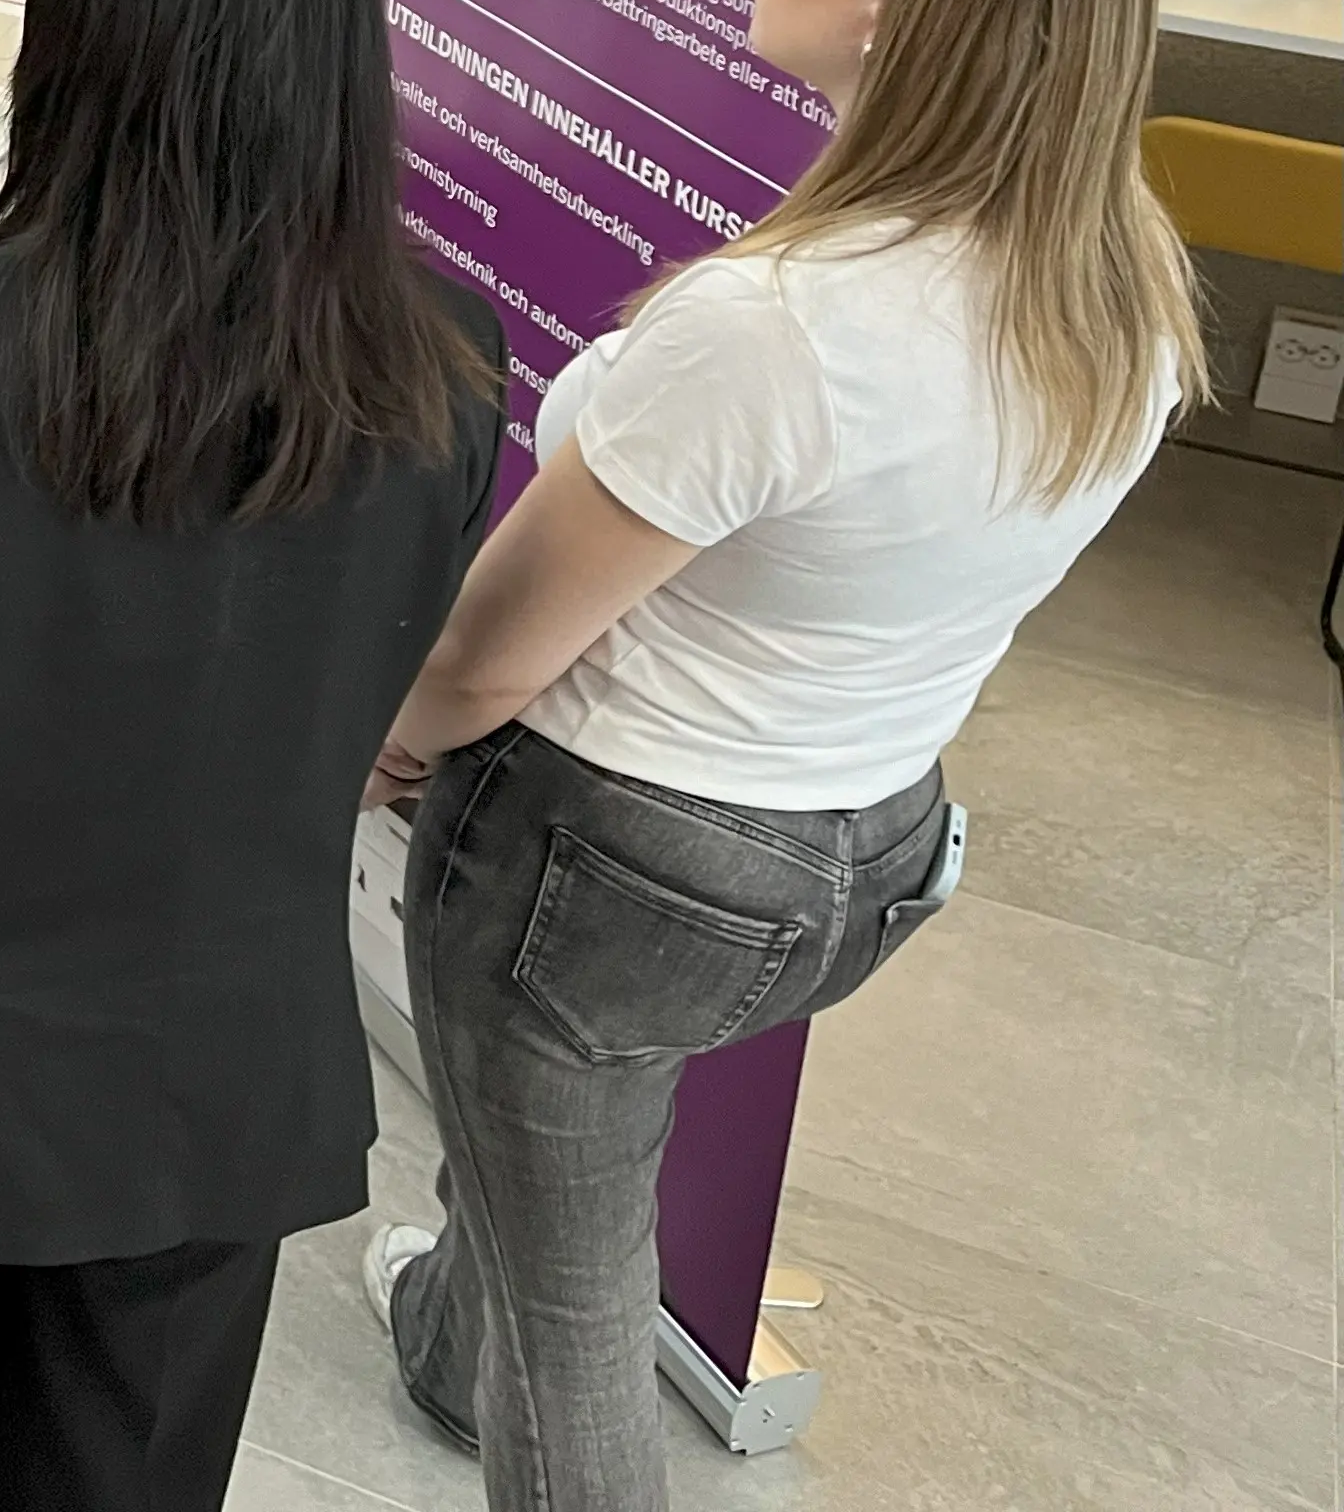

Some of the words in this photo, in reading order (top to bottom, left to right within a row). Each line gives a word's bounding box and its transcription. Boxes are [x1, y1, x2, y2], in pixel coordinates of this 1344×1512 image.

[728, 61, 770, 93] eller
[771, 84, 800, 111] att
[391, 71, 438, 118] valitet
[440, 107, 466, 137] och
[470, 126, 655, 266] verksamhetsutveckling
[400, 144, 498, 228] nomistyrning
[530, 90, 671, 199] INNEHÅLLER
[404, 210, 497, 291] ktionsteknik
[499, 281, 528, 315] och
[531, 303, 591, 353] autom
